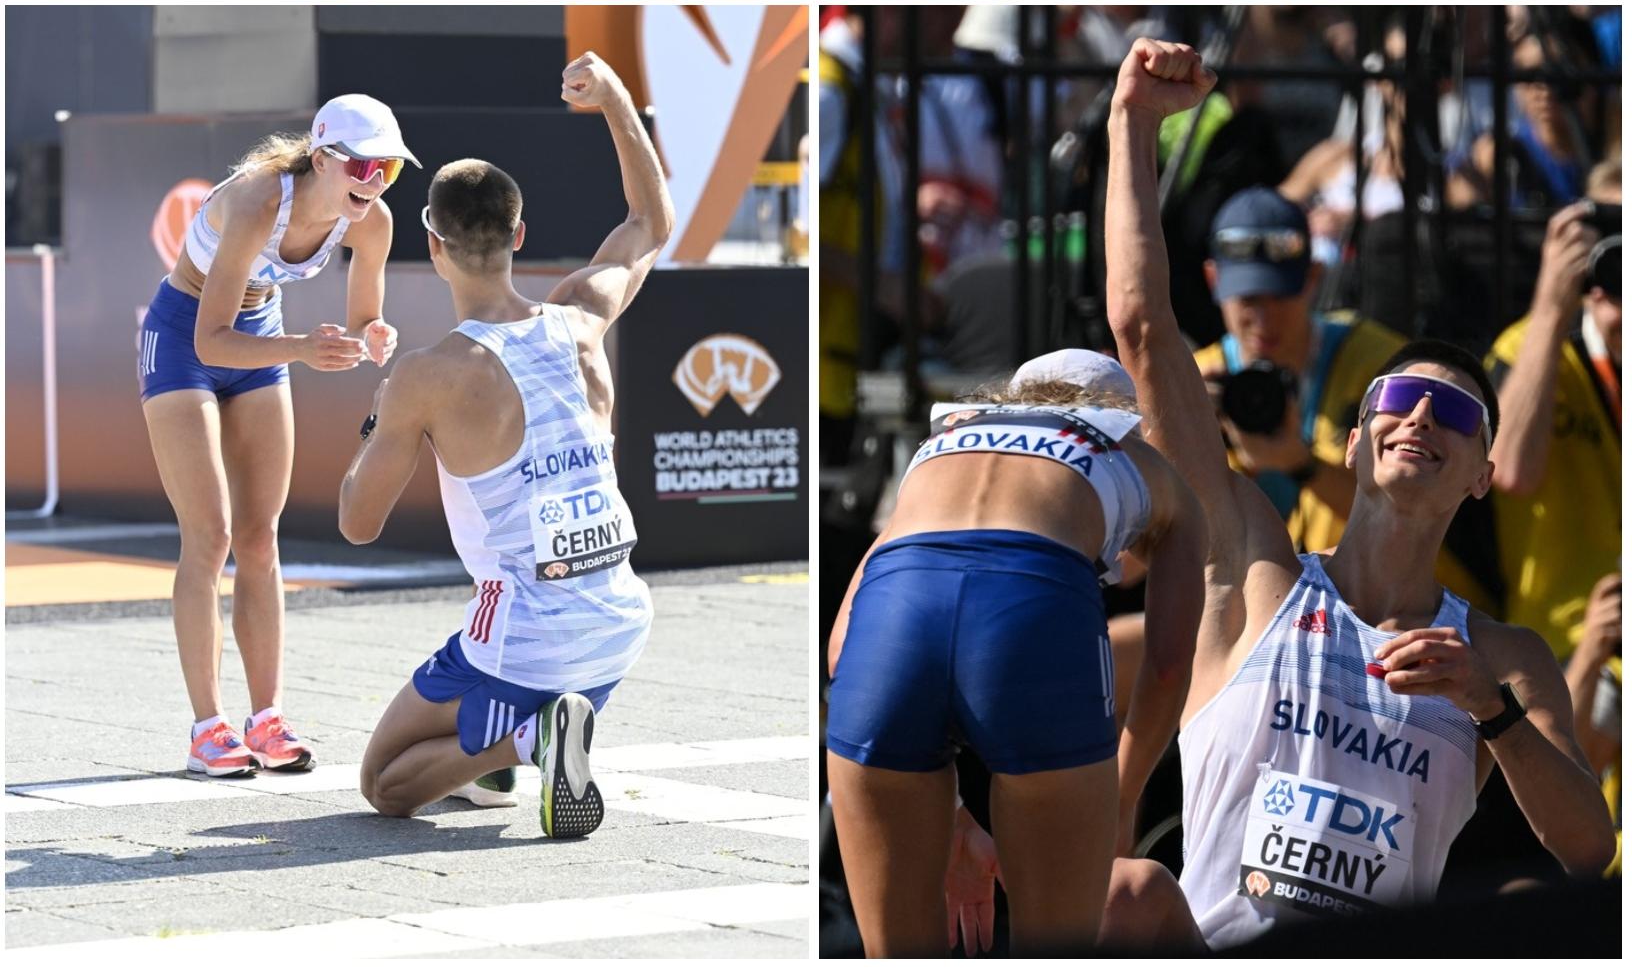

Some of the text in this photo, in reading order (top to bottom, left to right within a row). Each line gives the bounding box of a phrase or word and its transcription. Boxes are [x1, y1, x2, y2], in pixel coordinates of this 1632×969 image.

[653, 447, 799, 470] CHAMPIONSHIPS
[654, 428, 799, 450] WORLD ATHLETICS
[917, 433, 1094, 478] SLOVAKIA
[521, 443, 609, 484] SLOVAKIA
[655, 466, 799, 492] BUDAPEST 23
[552, 514, 622, 558] ČERNÝ
[572, 550, 621, 572] BUDAPEST
[1270, 699, 1430, 783] SLOVAKIA
[1299, 784, 1405, 851] TDK
[1260, 824, 1386, 895] ČERNÝ
